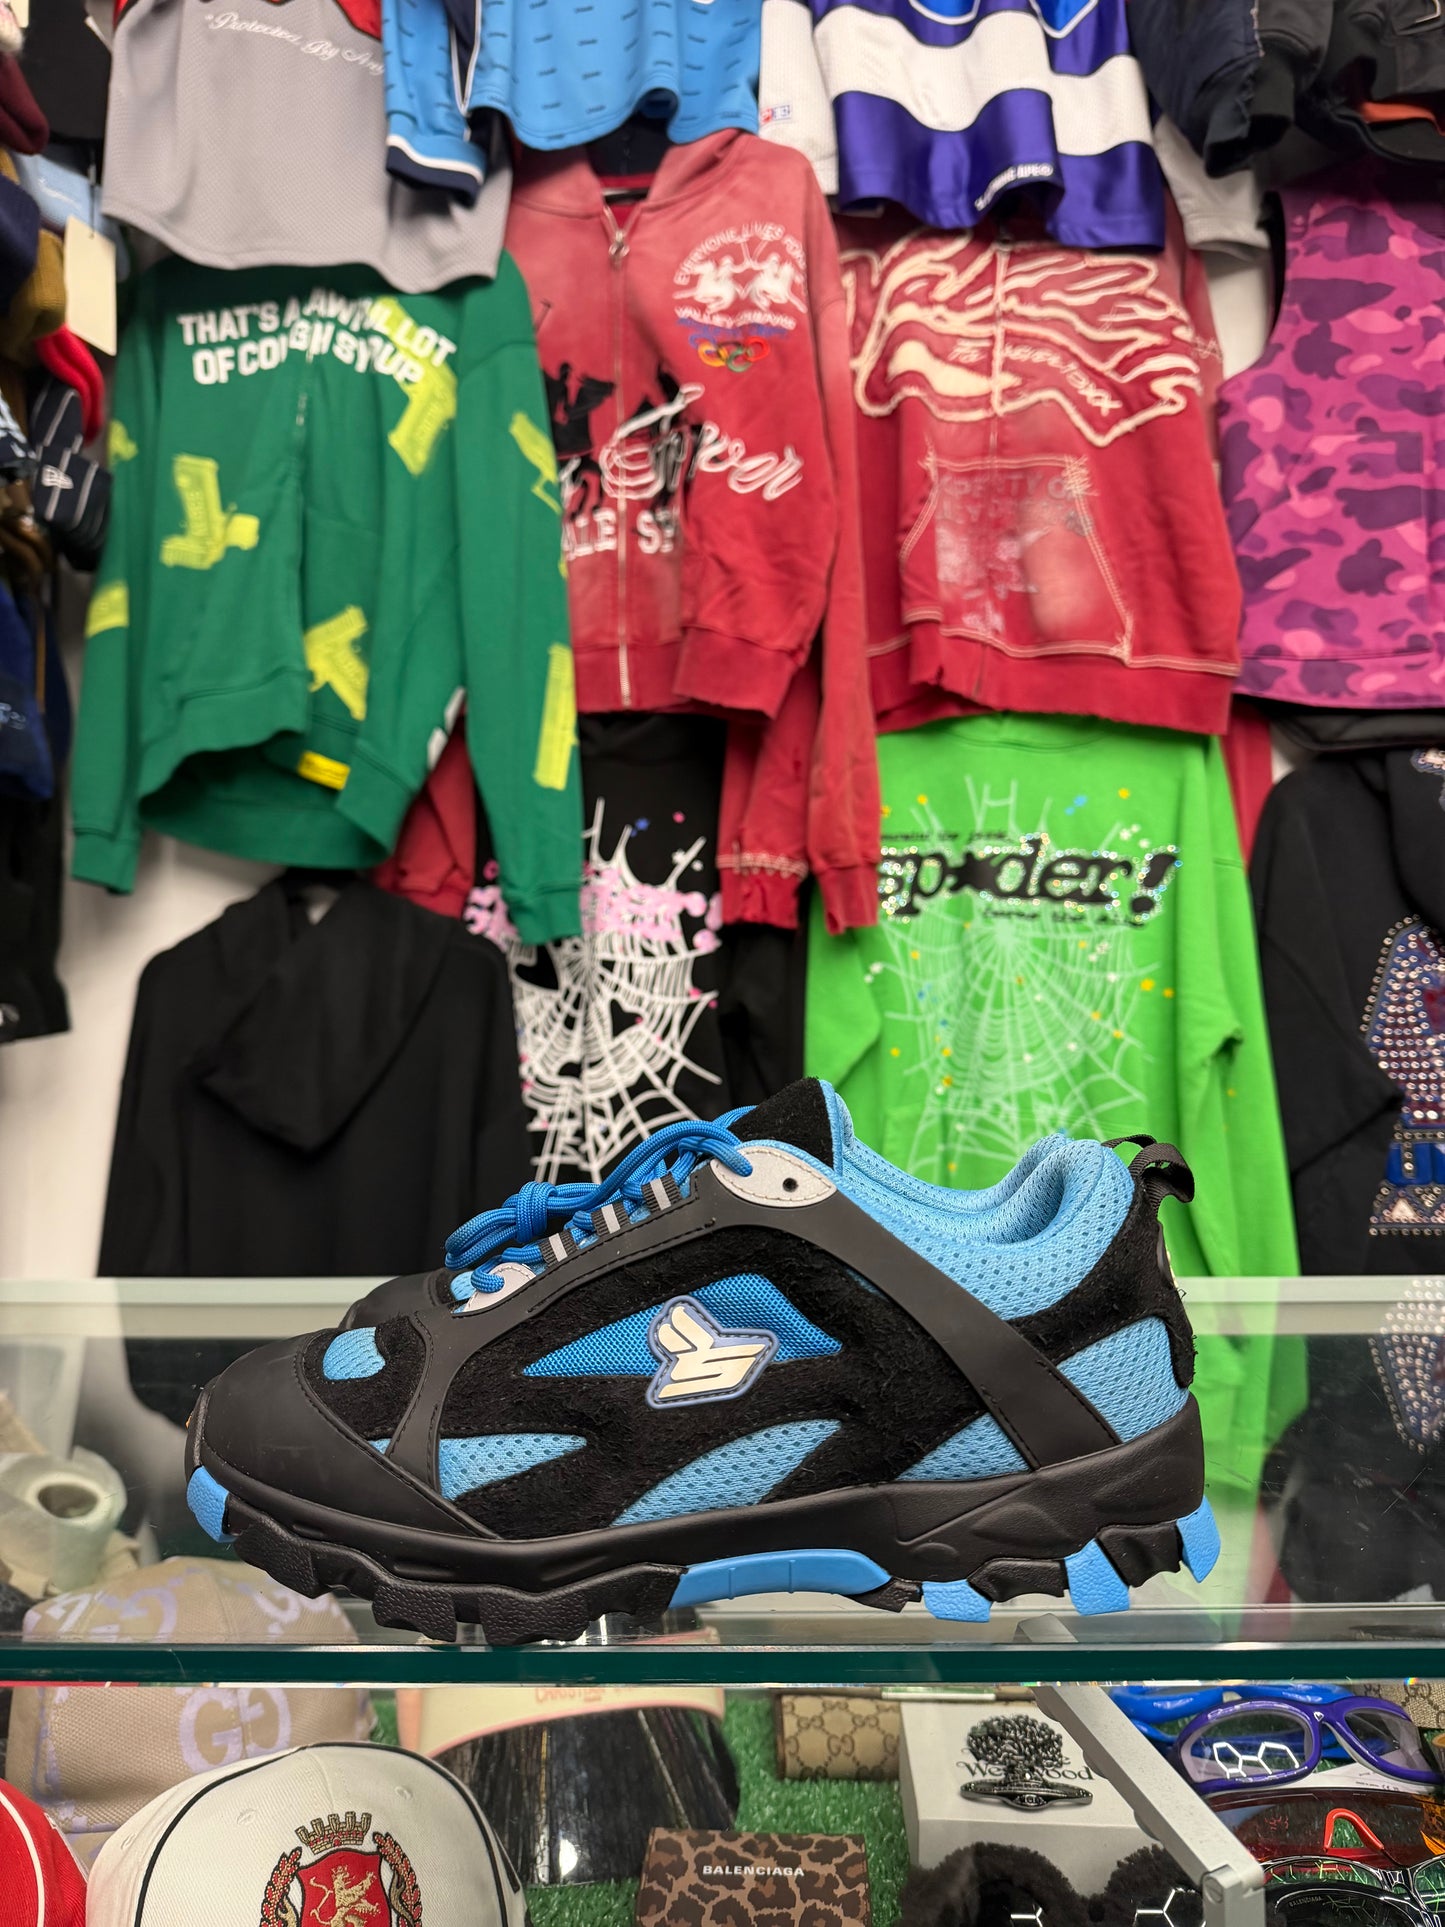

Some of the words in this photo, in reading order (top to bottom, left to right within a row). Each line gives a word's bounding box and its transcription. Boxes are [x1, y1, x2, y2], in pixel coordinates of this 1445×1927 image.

[177, 302, 280, 346] THAT'S
[282, 296, 301, 328] A
[398, 325, 457, 368] LOT
[192, 347, 236, 385] OF
[955, 1760, 1096, 1781] Weood
[702, 1865, 805, 1877] BALENCIAGA
